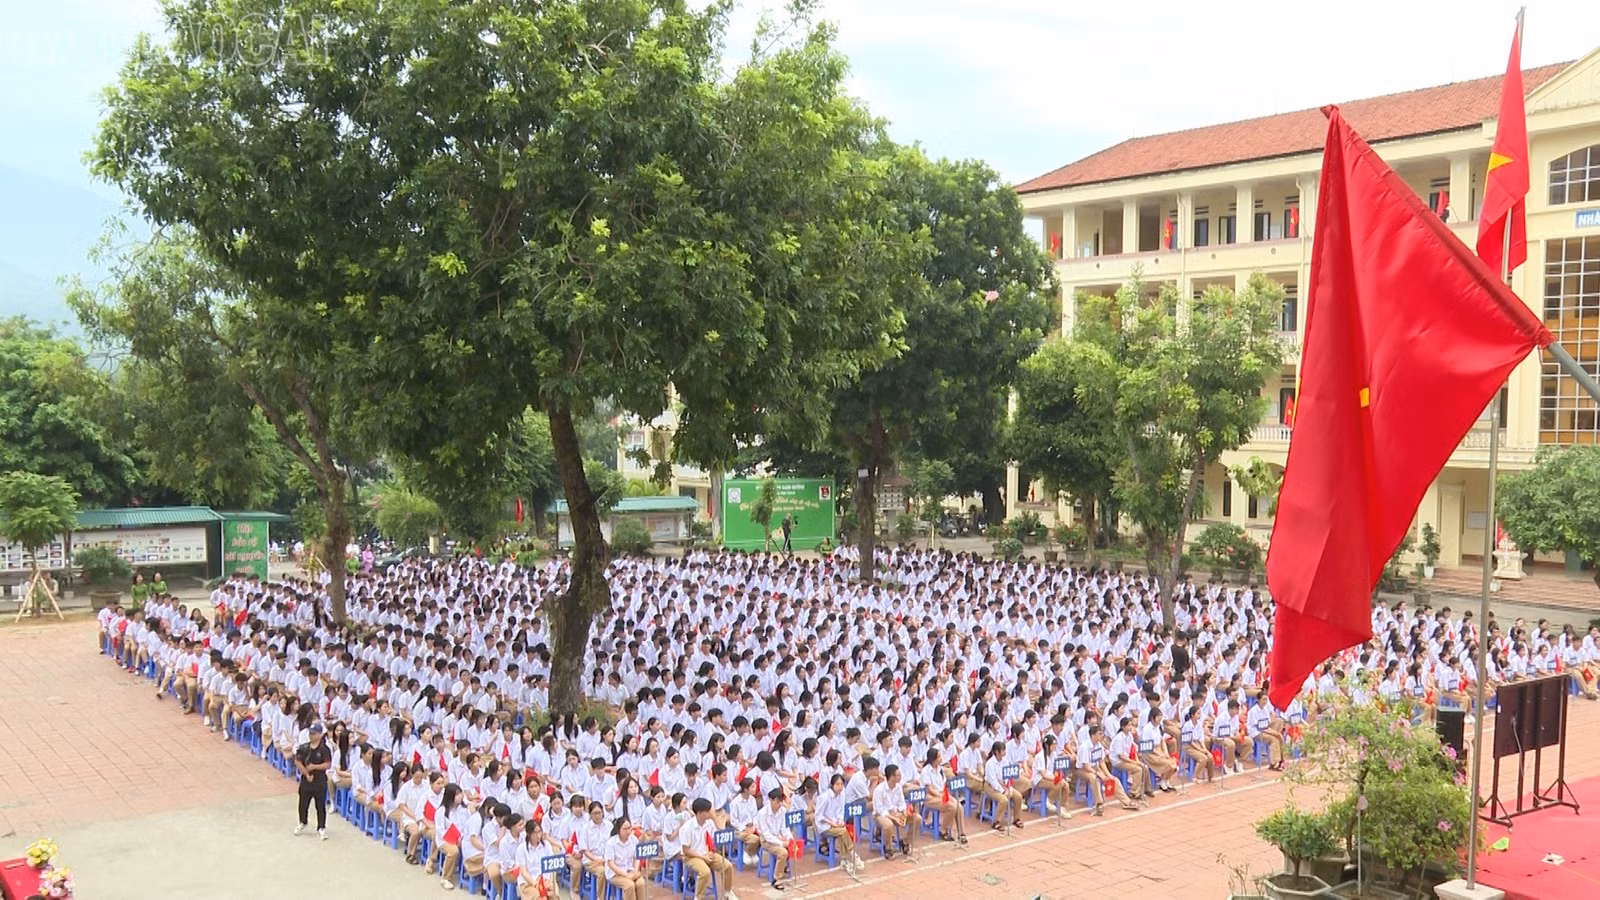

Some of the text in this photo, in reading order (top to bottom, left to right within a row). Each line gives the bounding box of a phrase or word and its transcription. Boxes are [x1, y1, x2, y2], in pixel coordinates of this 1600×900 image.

[1055, 758, 1070, 769] 12A1
[1003, 766, 1019, 777] 12A2
[950, 778, 966, 789] 12A3
[909, 790, 926, 801] 12A4
[848, 804, 863, 816] 12B
[787, 812, 802, 825] 12C
[715, 831, 733, 844] 12D1
[637, 844, 658, 857] 12D2
[542, 857, 565, 870] 12D3
